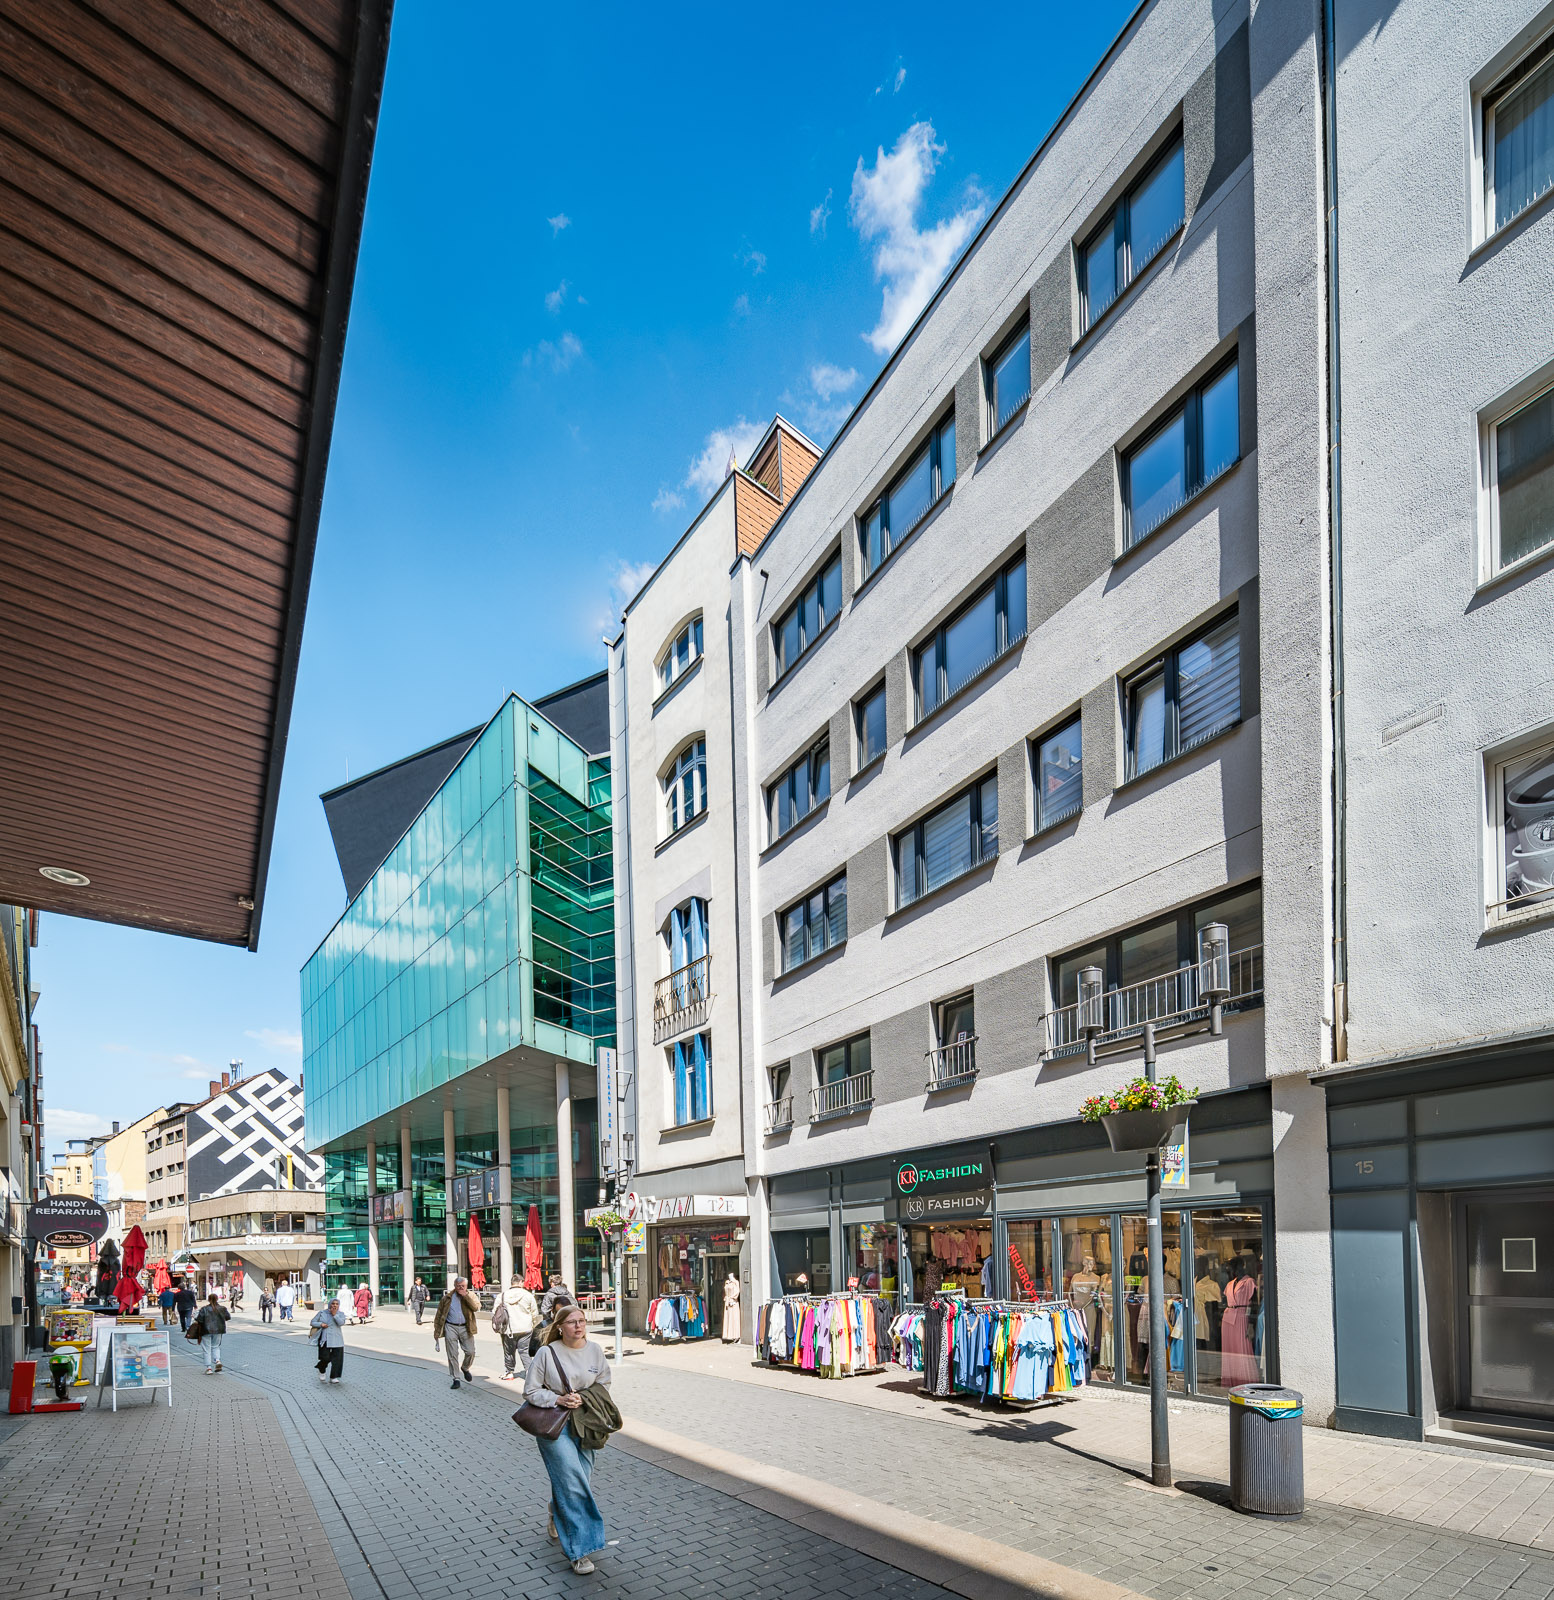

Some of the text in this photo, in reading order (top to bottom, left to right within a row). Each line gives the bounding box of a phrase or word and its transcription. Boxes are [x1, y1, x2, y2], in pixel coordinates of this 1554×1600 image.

[899, 1163, 983, 1185] KR FASHION
[1355, 1160, 1374, 1174] 15
[35, 1207, 101, 1216] REPARATUR
[908, 1196, 985, 1213] KR FASHION
